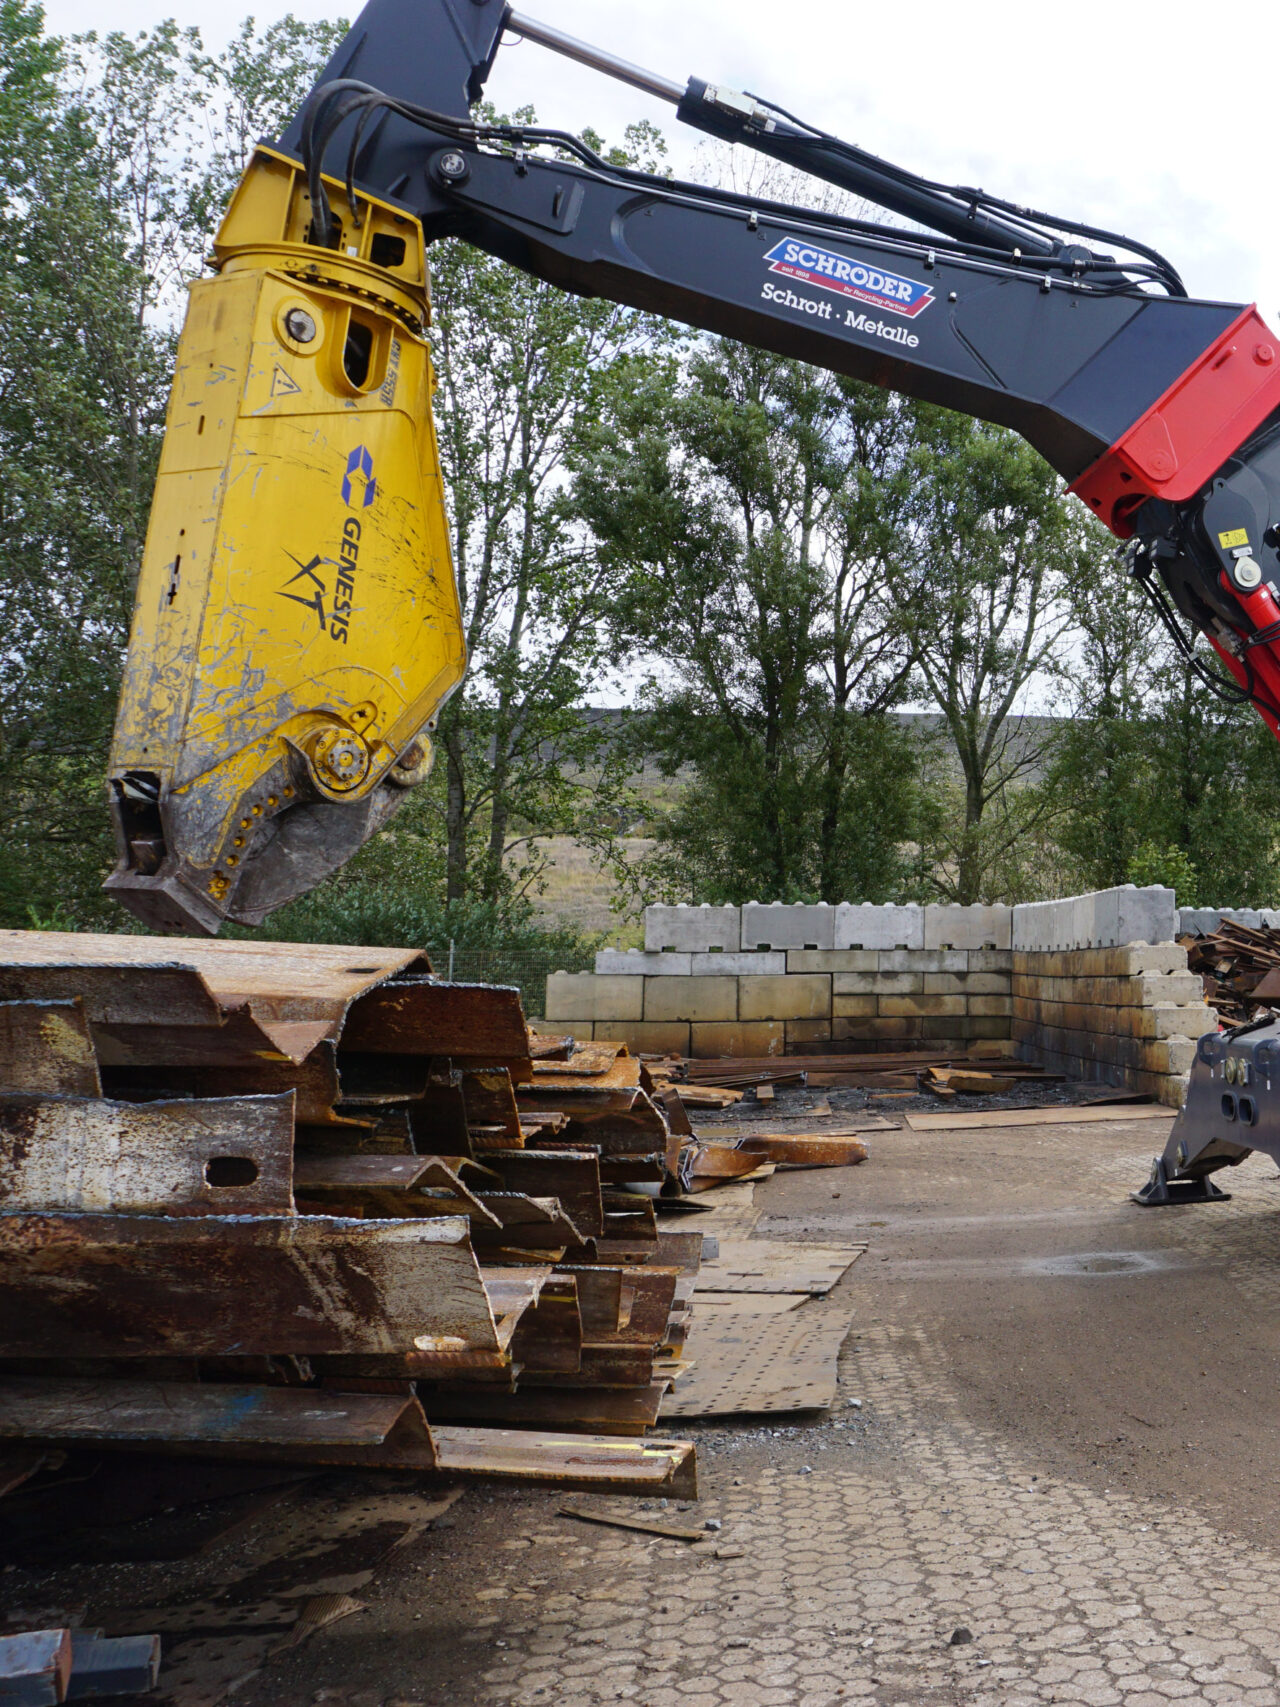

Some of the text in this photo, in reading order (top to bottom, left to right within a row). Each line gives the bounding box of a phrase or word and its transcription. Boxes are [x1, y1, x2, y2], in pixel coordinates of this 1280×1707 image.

[761, 283, 920, 348] Schrott Metalle
[853, 289, 908, 312] Recycling-Partner
[330, 517, 362, 645] GENESIS
